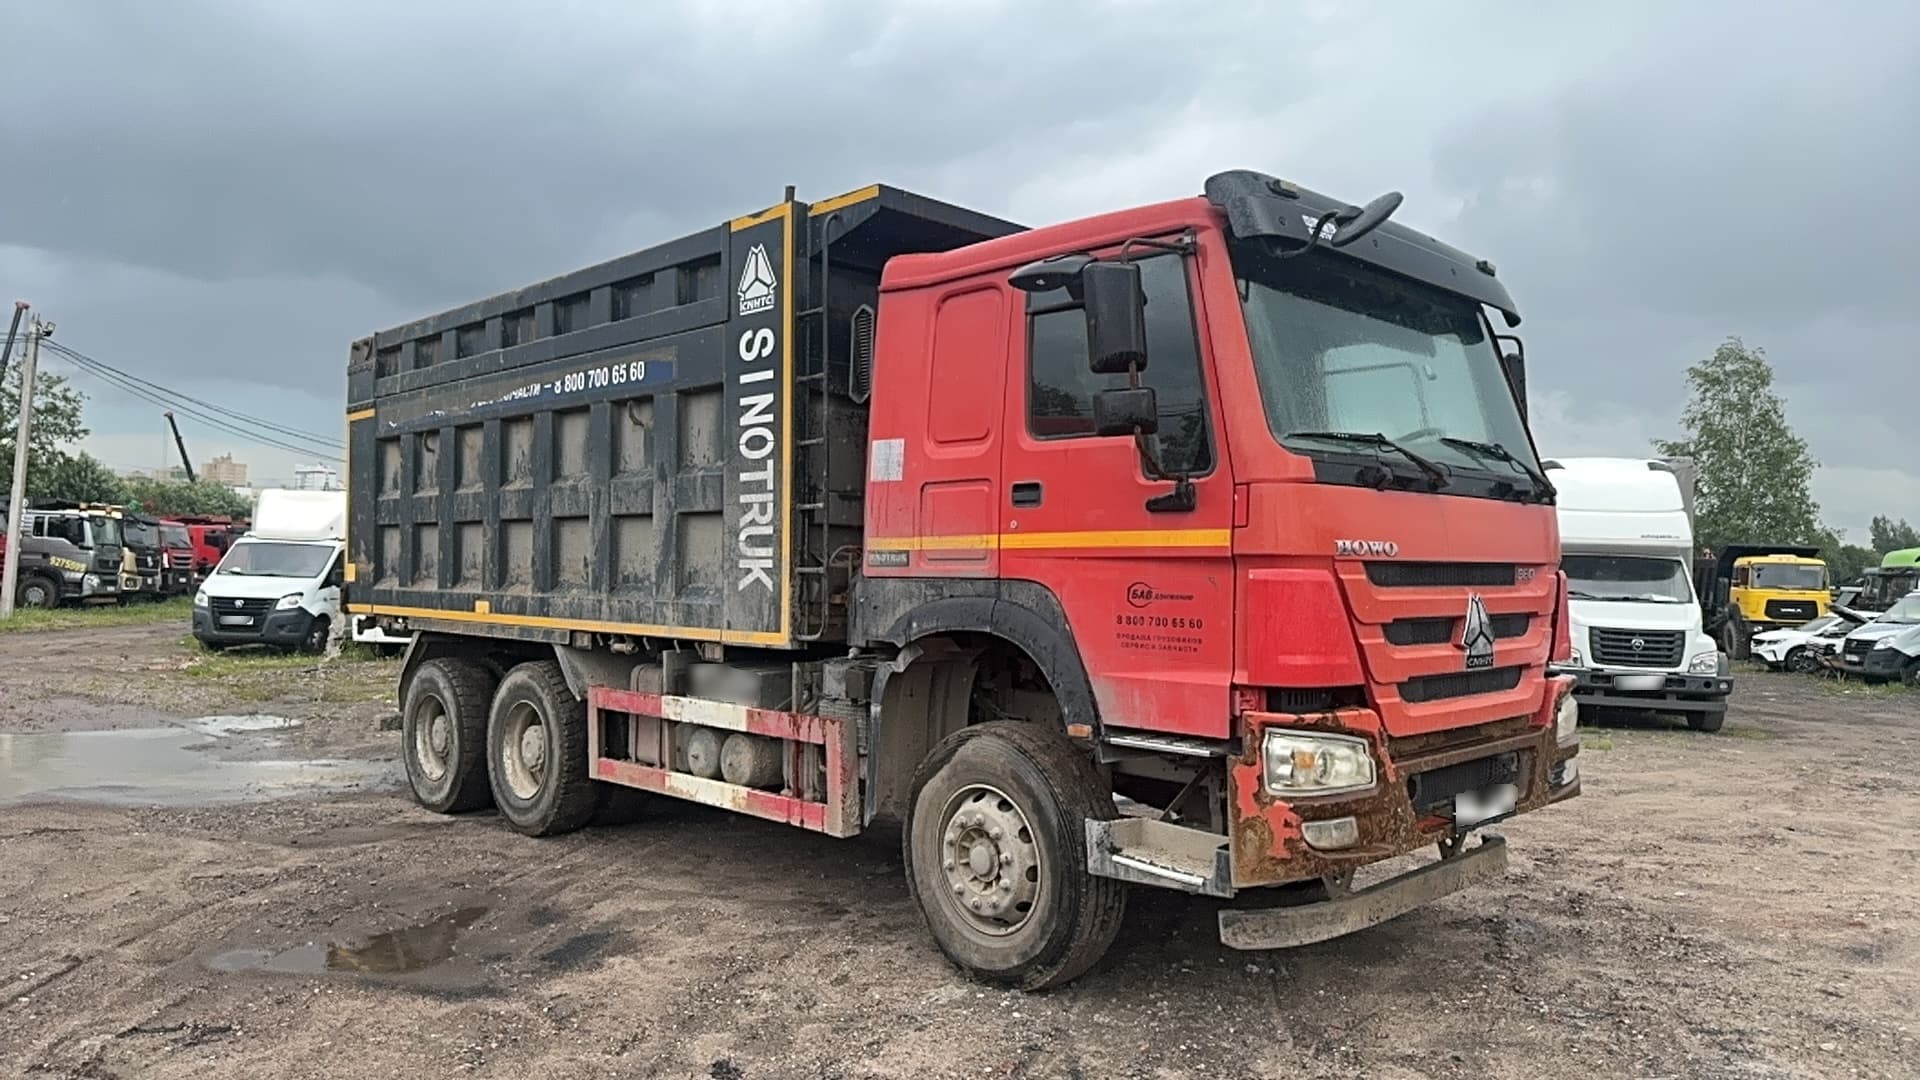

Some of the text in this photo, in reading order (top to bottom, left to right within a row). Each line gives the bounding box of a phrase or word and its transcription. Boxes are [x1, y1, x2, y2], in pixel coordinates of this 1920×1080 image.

[742, 296, 775, 311] CNHTC
[564, 371, 585, 392] 800
[587, 366, 609, 389] 700
[612, 363, 627, 385] 65
[630, 360, 645, 382] 60
[738, 328, 775, 593] SINOTRUK
[1334, 539, 1399, 557] HOWO
[1116, 614, 1203, 630] 8 800 700 65 60
[1116, 632, 1151, 641] ПРОДАЖА
[1120, 641, 1150, 650] СЕРВИС
